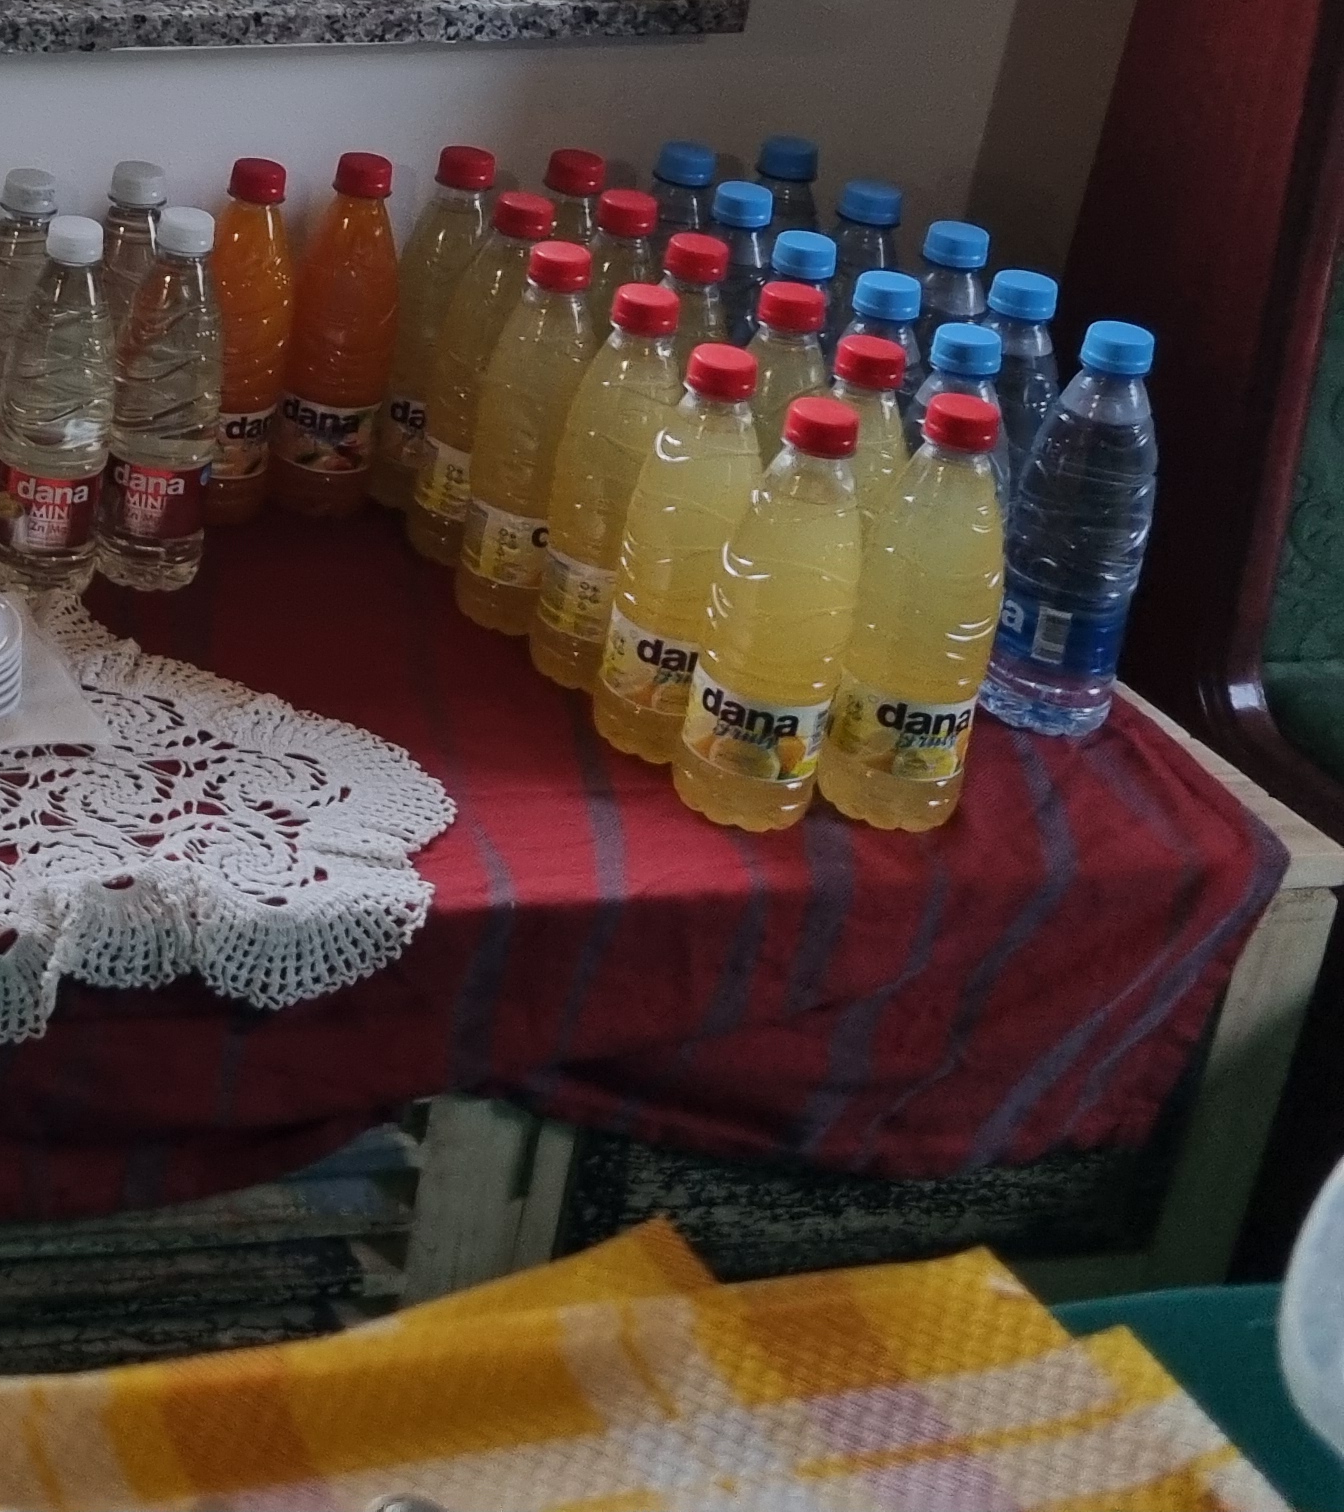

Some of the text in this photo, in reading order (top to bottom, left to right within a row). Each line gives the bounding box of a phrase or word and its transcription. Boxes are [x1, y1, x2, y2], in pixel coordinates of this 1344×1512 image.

[225, 417, 272, 438] da
[283, 397, 359, 434] dana
[390, 400, 426, 429] da
[17, 478, 89, 504] dana
[115, 464, 185, 495] dana
[30, 503, 69, 520] MIN
[637, 639, 698, 672] da
[702, 687, 799, 737] dana
[877, 702, 971, 736] dana
